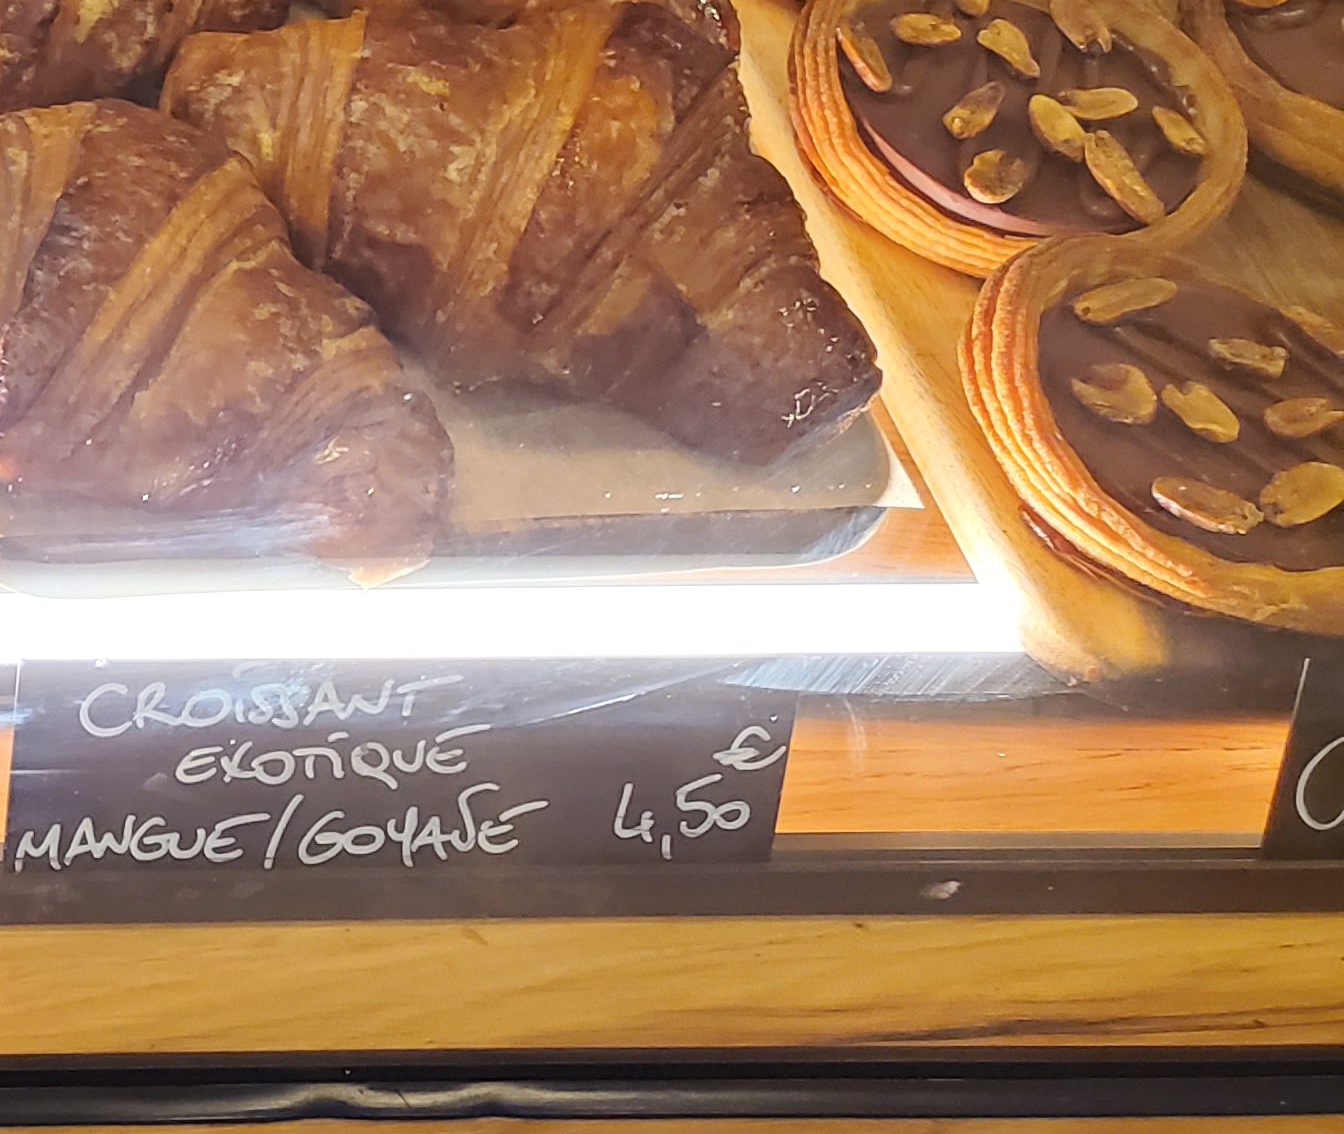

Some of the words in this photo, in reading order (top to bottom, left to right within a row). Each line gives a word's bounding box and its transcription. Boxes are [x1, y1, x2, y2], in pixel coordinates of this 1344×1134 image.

[78, 664, 464, 738] CROISSANT
[173, 723, 492, 791] EXOTIQUE
[613, 773, 752, 861] 4,50
